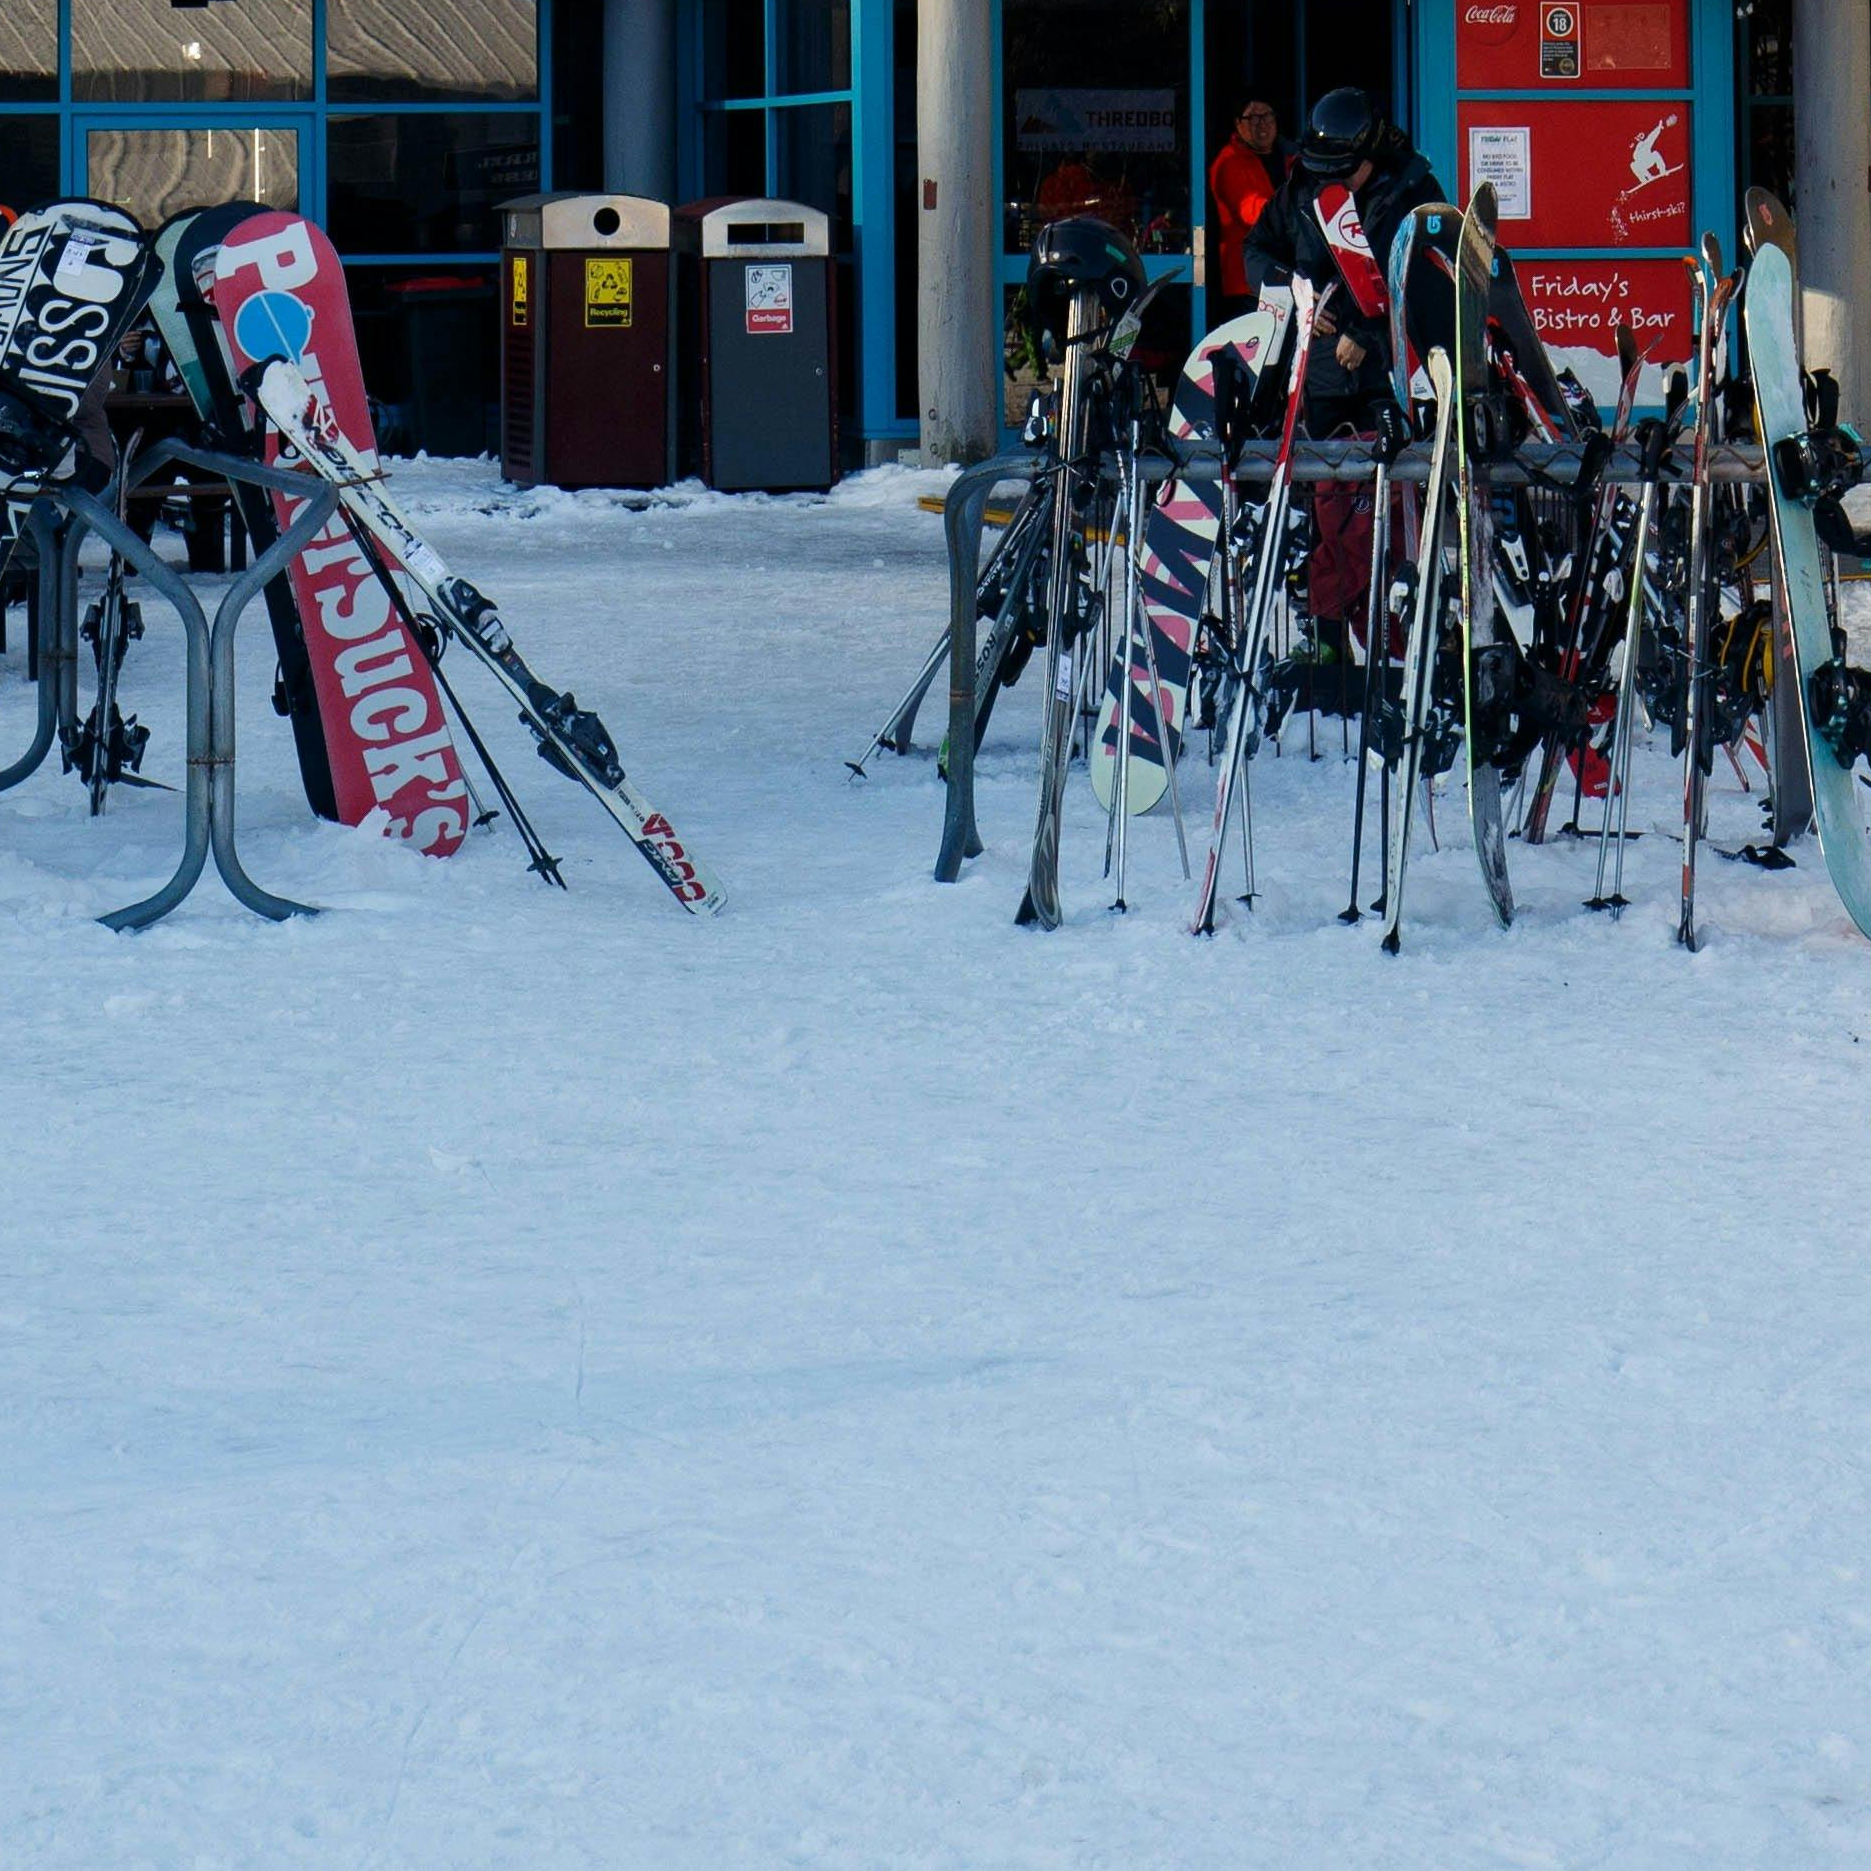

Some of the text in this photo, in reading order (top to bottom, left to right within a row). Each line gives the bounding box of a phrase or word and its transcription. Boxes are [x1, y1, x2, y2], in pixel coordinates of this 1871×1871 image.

[1465, 5, 1517, 24] Coca-Cola
[1553, 17, 1567, 32] 18
[1086, 110, 1174, 128] THREDBO
[1629, 202, 1686, 224] thirst-ski?
[1532, 273, 1629, 308] Friday's
[590, 307, 628, 318] Recycling
[751, 313, 788, 325] Garbage
[1533, 307, 1675, 331] Bistro & Bar
